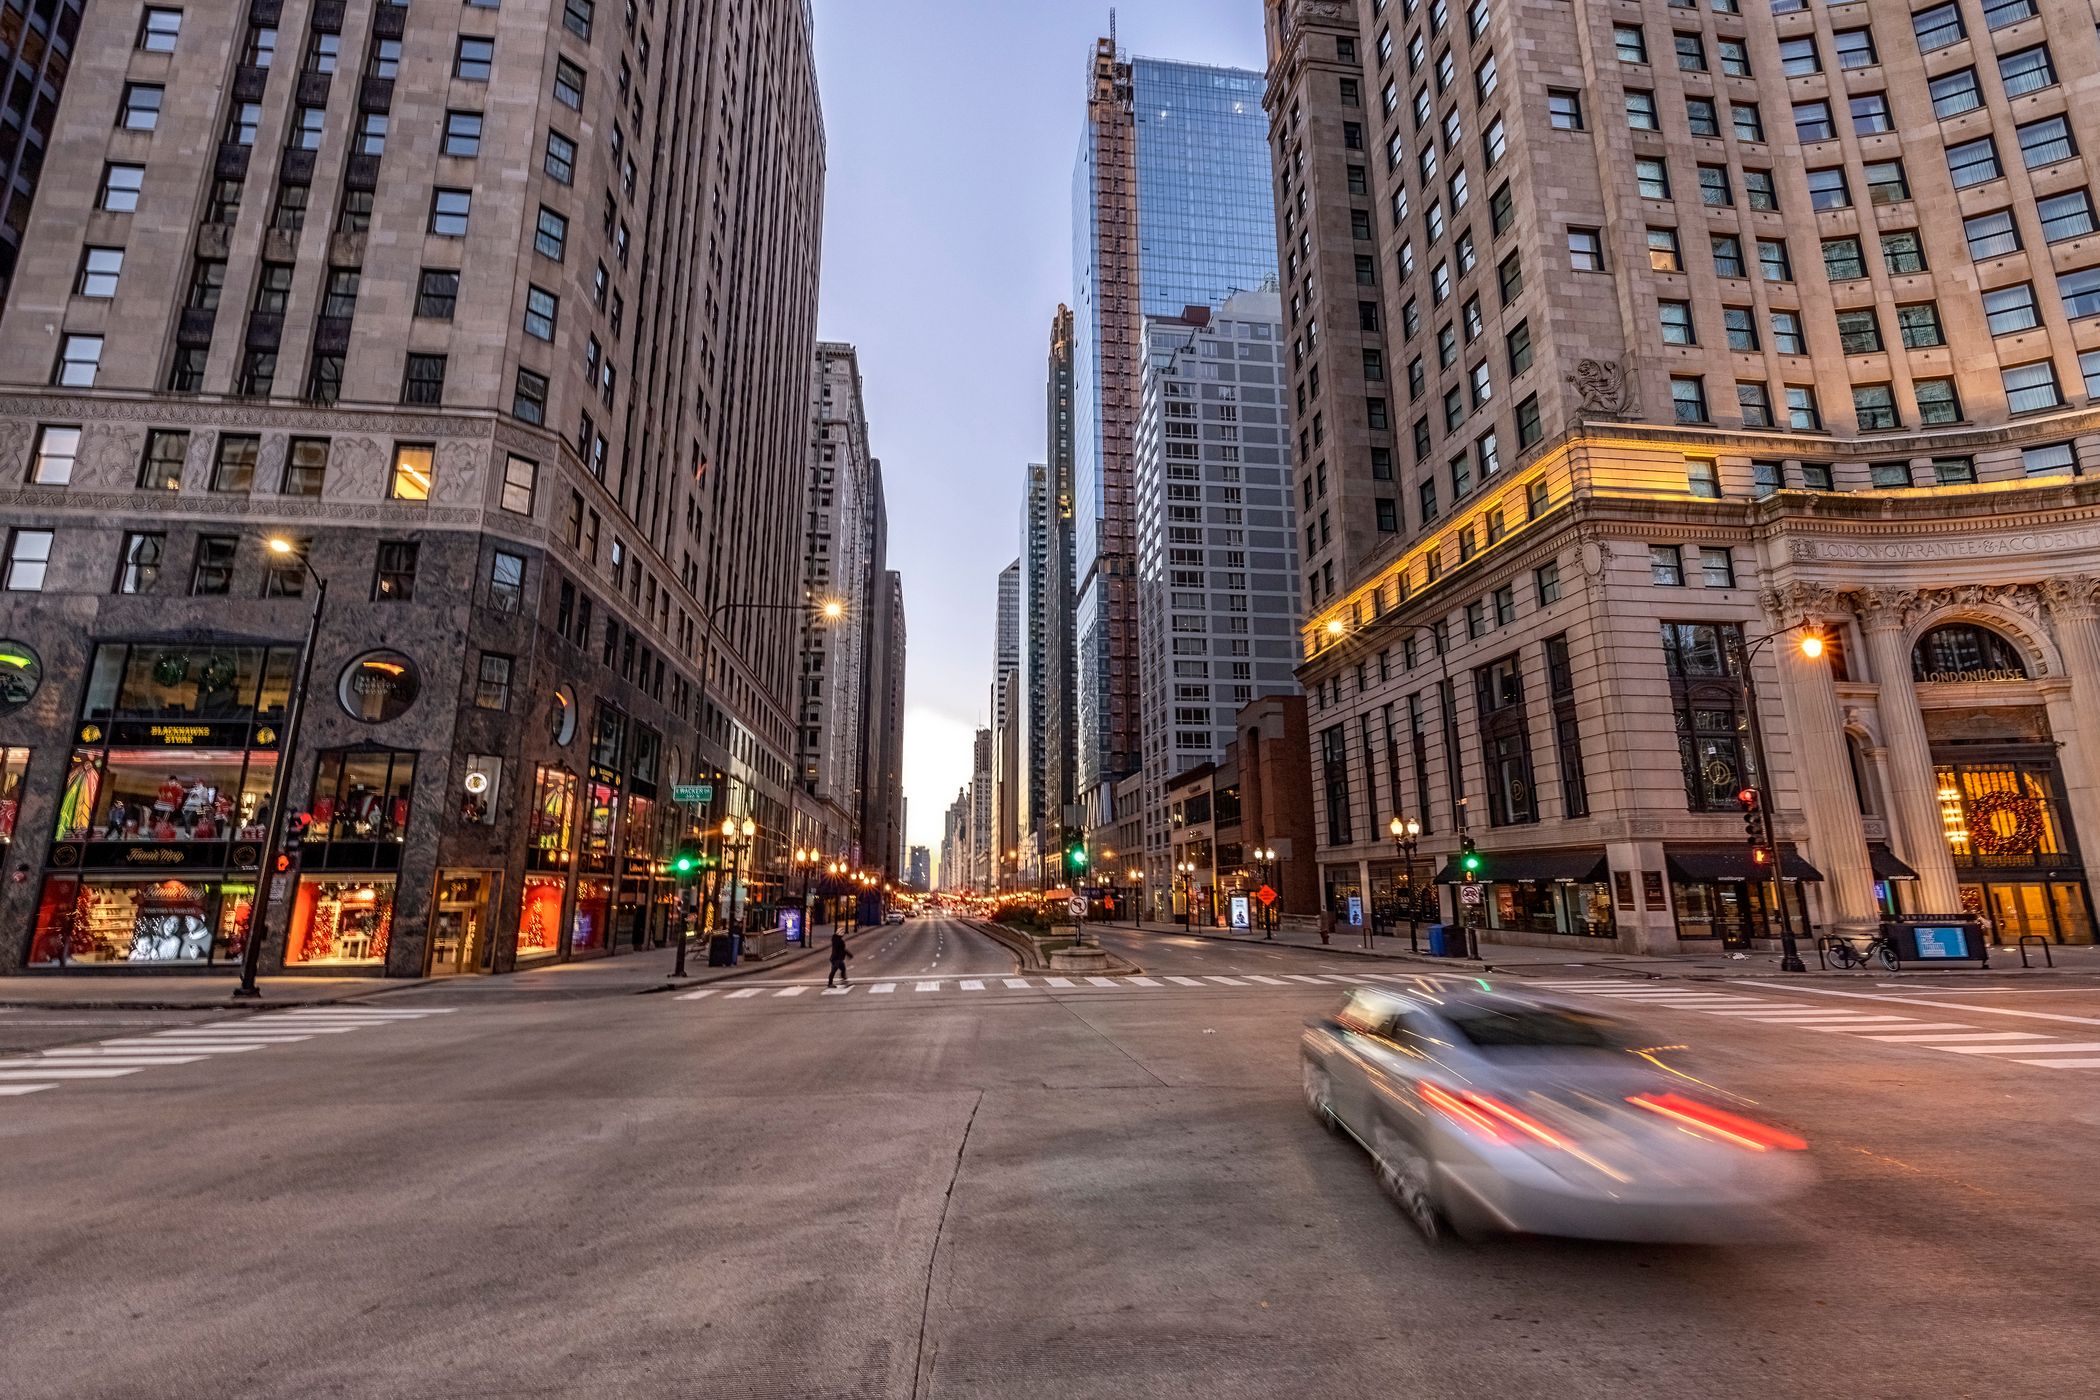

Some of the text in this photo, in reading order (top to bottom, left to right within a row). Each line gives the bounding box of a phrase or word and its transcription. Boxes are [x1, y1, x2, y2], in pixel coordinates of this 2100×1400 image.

[1820, 543, 1879, 559] LONDON
[1999, 531, 2089, 553] ACCIDENT
[1922, 668, 2024, 683] LONDONHOUSE
[151, 726, 210, 736] BLACKHAWKS
[164, 736, 194, 744] STORE
